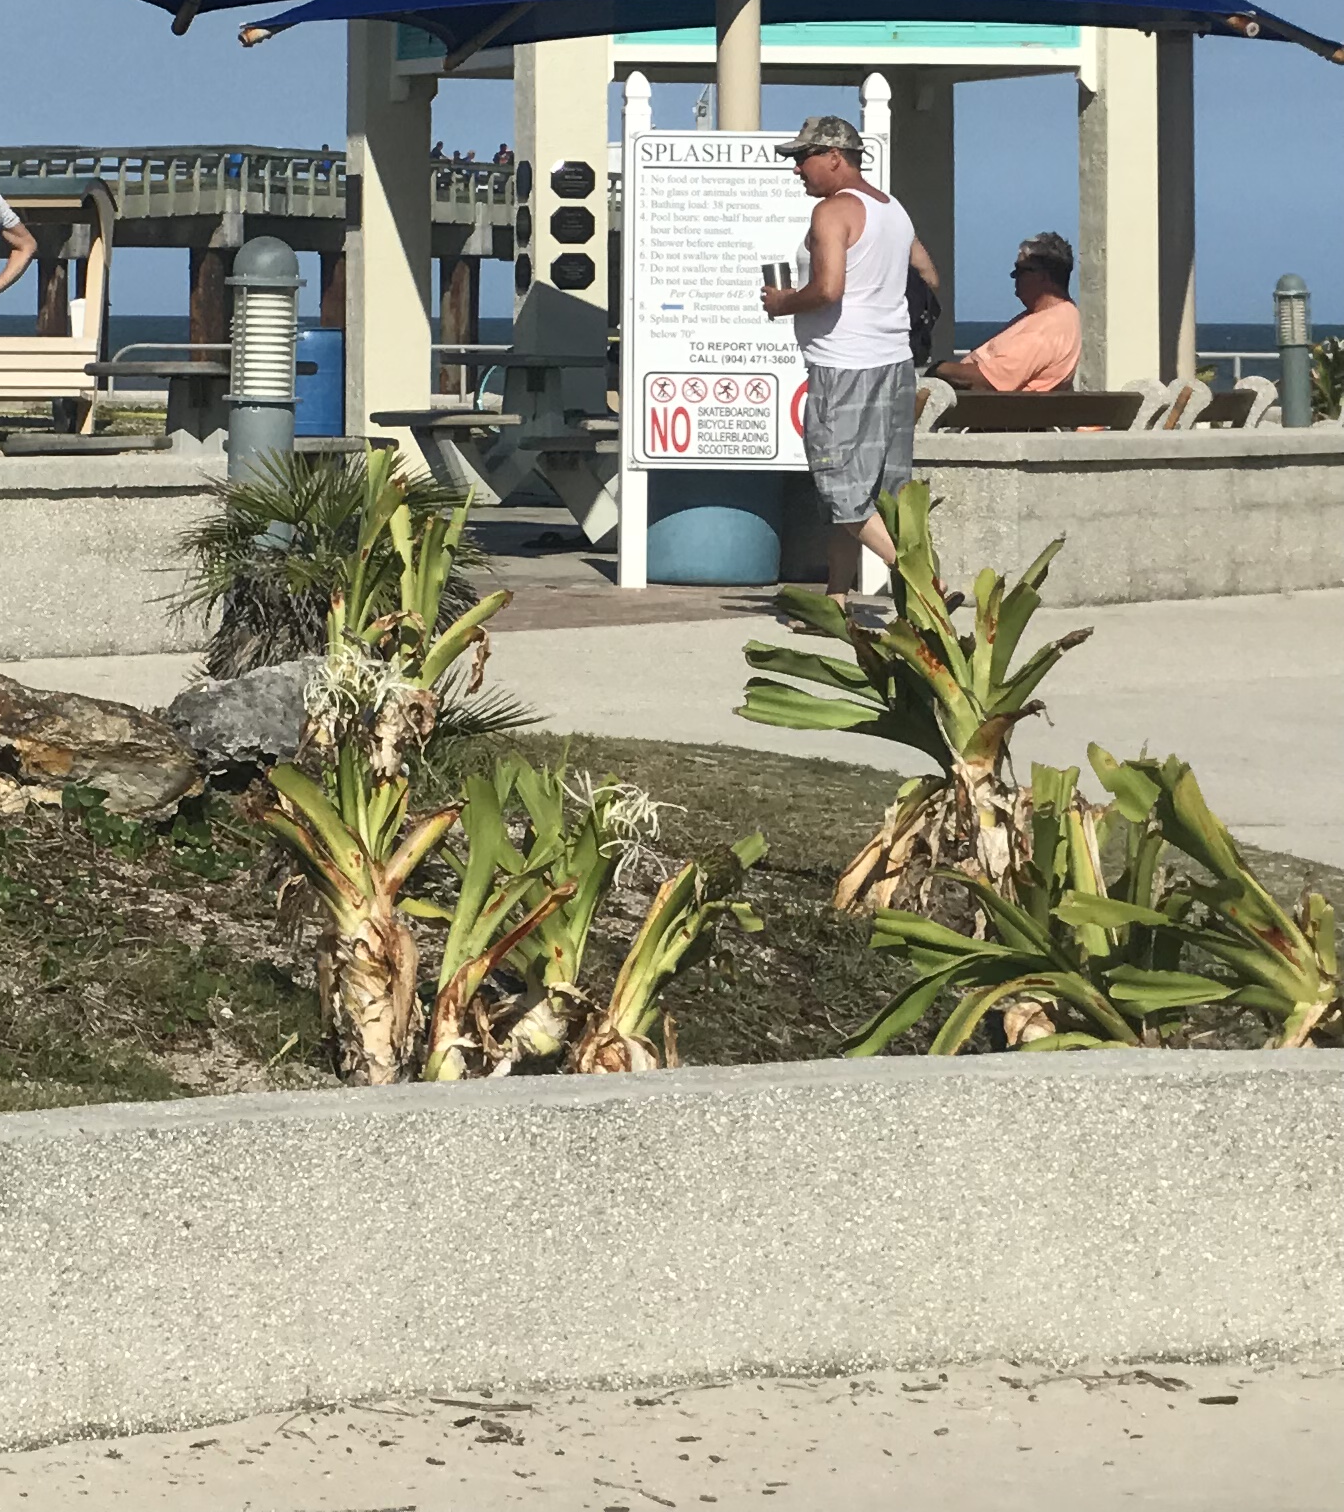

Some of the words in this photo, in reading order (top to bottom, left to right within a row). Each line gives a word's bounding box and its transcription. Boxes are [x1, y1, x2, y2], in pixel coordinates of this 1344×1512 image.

[641, 143, 732, 163] SPLASH
[640, 174, 647, 183] 1.
[651, 175, 664, 183] No
[667, 175, 687, 183] food
[701, 175, 745, 186] beverages
[759, 176, 778, 186] pool
[640, 187, 647, 196] 2.
[651, 187, 664, 195] No
[667, 188, 688, 198] glass
[703, 188, 737, 197] animals
[740, 189, 768, 197] within
[771, 189, 782, 197] 50
[785, 190, 800, 198] feet
[640, 200, 647, 209] 3.
[651, 200, 685, 211] Bathing
[726, 203, 762, 212] persons.
[640, 213, 647, 222] 4.
[651, 213, 670, 221] Pool
[703, 214, 740, 222] one-half
[742, 214, 763, 222] hour
[765, 215, 785, 223] after
[650, 226, 671, 234] hour
[673, 226, 701, 235] before
[651, 238, 684, 247] Shower
[686, 239, 714, 248] before
[639, 251, 647, 260] 6.
[651, 251, 664, 259] Do
[683, 252, 718, 260] swallow
[738, 253, 758, 263] pool
[640, 264, 647, 273] 7.
[650, 264, 664, 272] Do
[682, 264, 717, 273] swallow
[720, 265, 733, 273] the
[651, 277, 664, 285] Do
[700, 277, 713, 286] the
[717, 277, 752, 286] fountain
[755, 278, 762, 286] if
[670, 289, 686, 298] Per
[688, 289, 725, 299] Chapter
[727, 290, 754, 298] 64E-9
[639, 302, 647, 310] 8.
[694, 303, 740, 311] Restrooms
[743, 303, 758, 311] and
[650, 314, 679, 324] Splash
[682, 315, 698, 323] Pad
[701, 315, 718, 323] will
[720, 315, 732, 324] be
[733, 315, 761, 324] closed
[650, 330, 677, 338] below
[689, 342, 704, 351] TO
[708, 342, 753, 351] REPORT
[689, 354, 718, 363] CALL
[721, 355, 746, 365] (904)
[750, 355, 796, 364] 471-3600
[698, 407, 770, 417] SKATEBOARDING
[651, 406, 691, 453] NO
[698, 420, 734, 430] BICYCLE
[736, 420, 766, 430] RIDING
[698, 432, 769, 442] ROLLERBLADING
[697, 445, 740, 455] SCOOTER
[742, 445, 772, 455] RIDING
